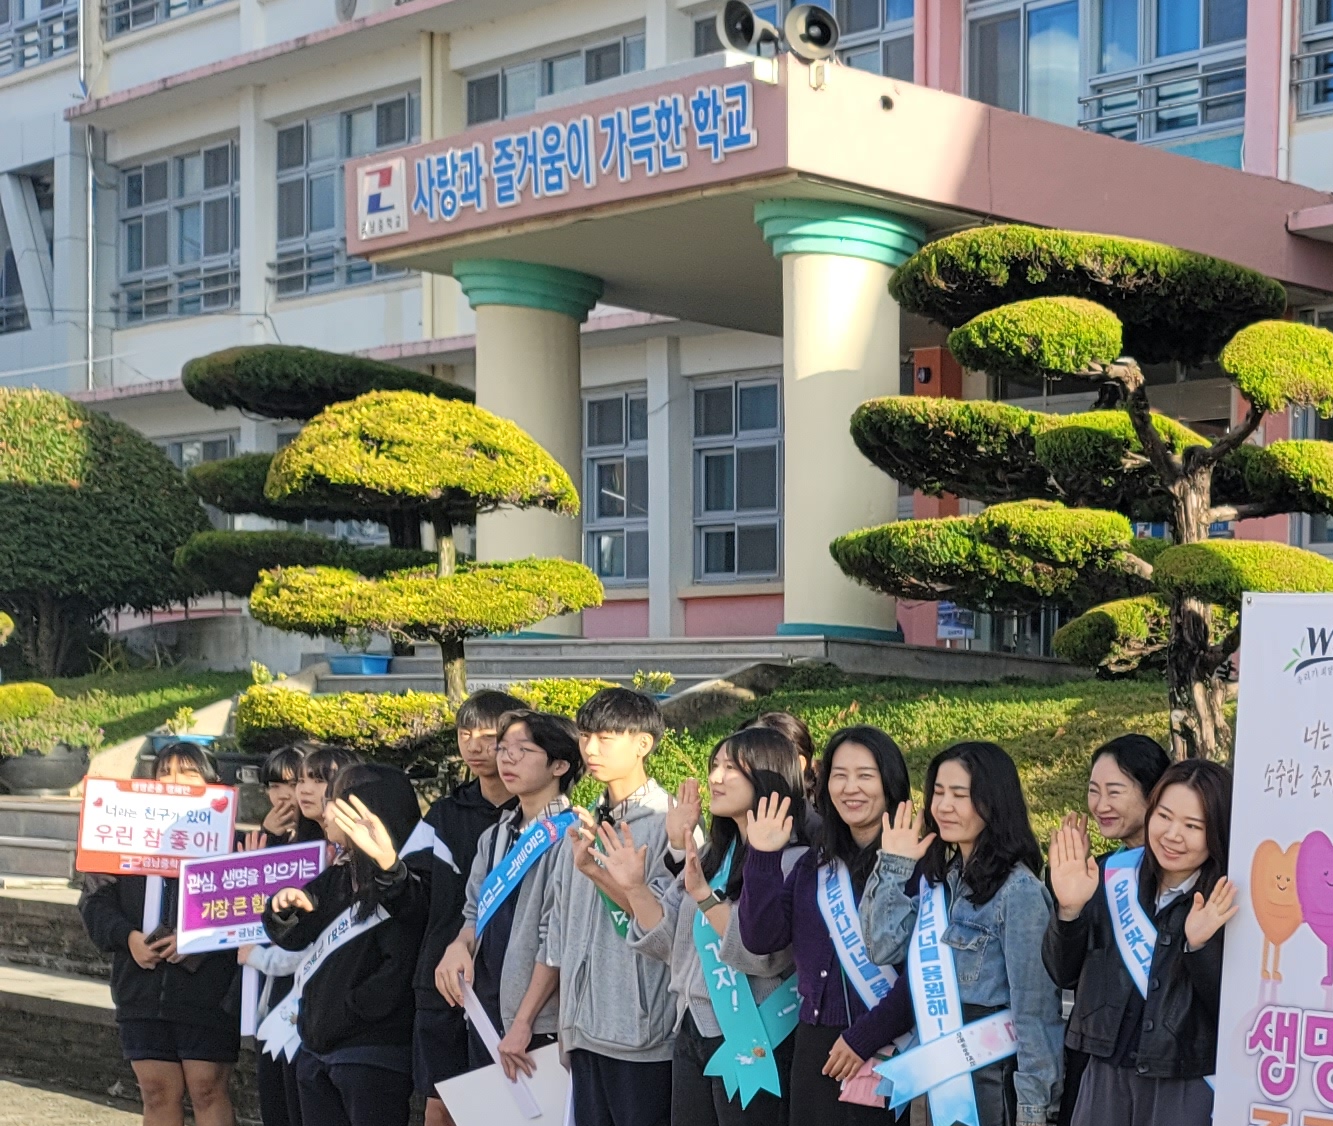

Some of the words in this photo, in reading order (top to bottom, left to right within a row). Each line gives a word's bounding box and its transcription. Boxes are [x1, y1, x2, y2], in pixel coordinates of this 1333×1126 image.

[413, 151, 485, 219] 사랑과
[493, 116, 594, 204] 즐거움이
[600, 96, 688, 182] 가득한
[691, 82, 756, 163] 학교
[1303, 719, 1333, 750] 너는
[1263, 758, 1304, 799] 소중한
[106, 805, 137, 818] 너라는
[144, 807, 180, 822] 친구가
[187, 810, 211, 825] 있어
[94, 825, 133, 846] 우린
[143, 827, 163, 848] 참
[170, 829, 219, 852] 좋아!
[186, 871, 217, 895] 관심,
[221, 867, 259, 889] 생명을
[263, 858, 317, 884] 일으키는
[201, 897, 229, 920] 가장
[232, 896, 247, 916] 큰
[918, 930, 940, 962] 너를
[922, 965, 949, 1037] 응원해!
